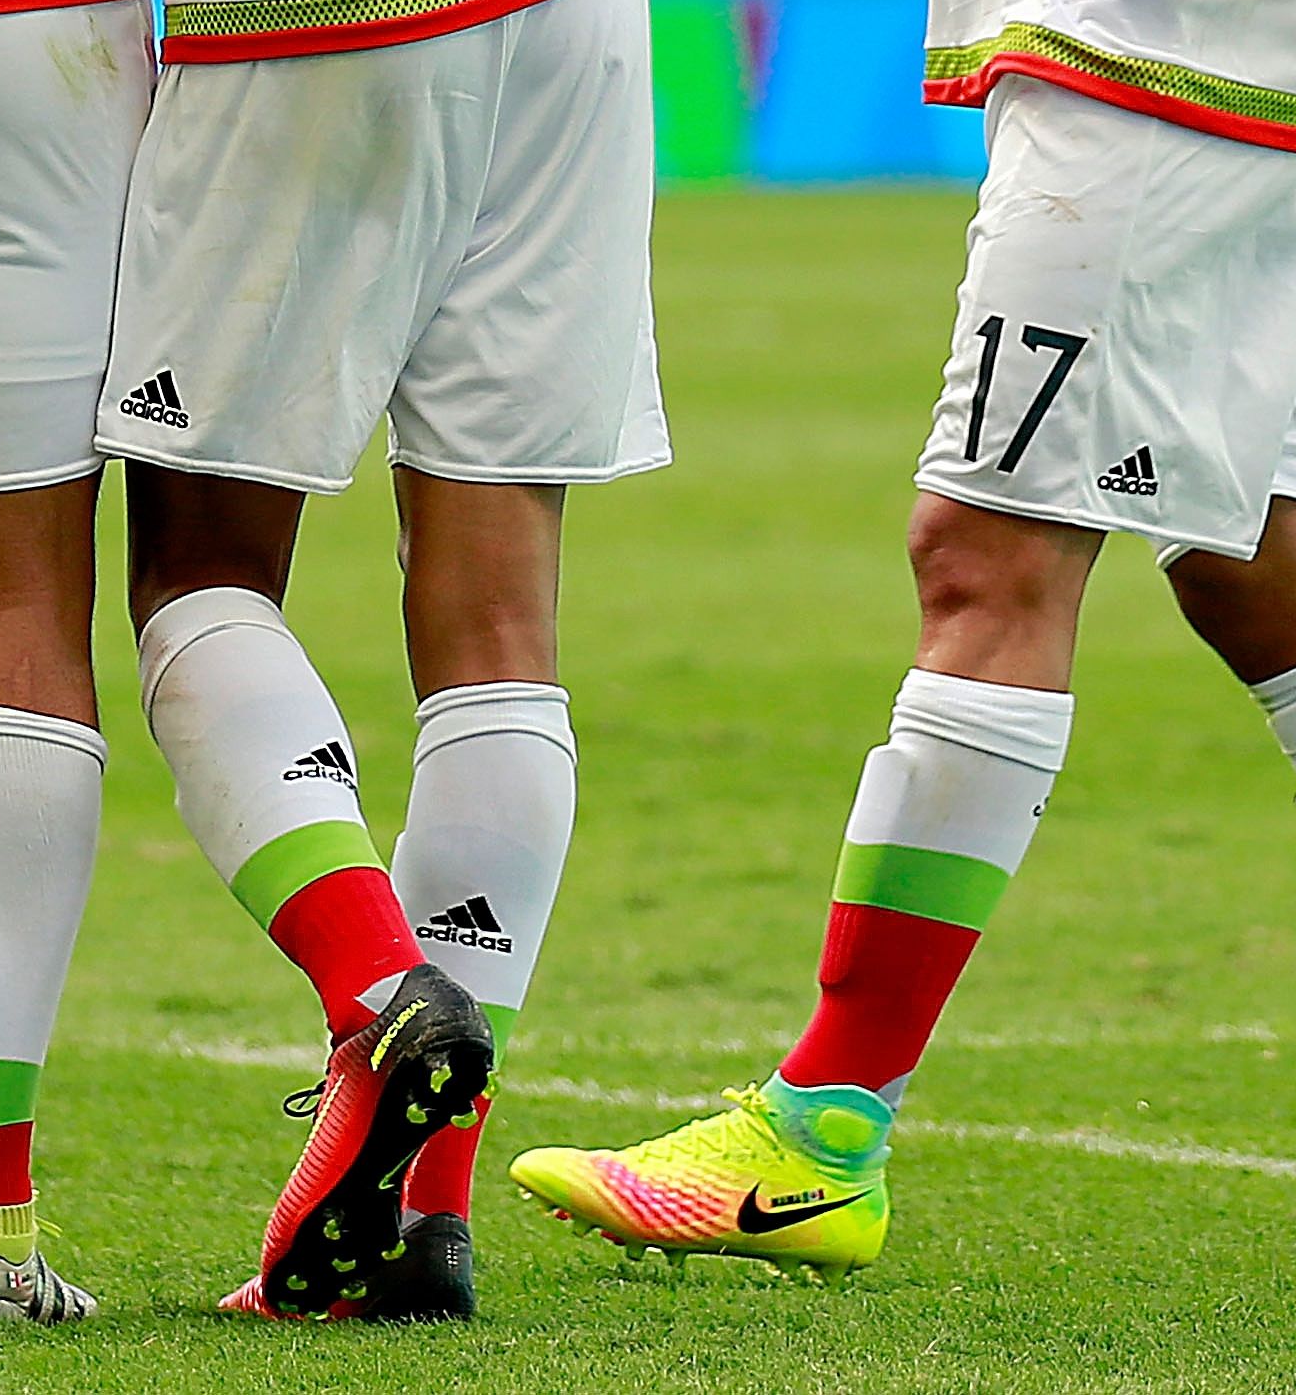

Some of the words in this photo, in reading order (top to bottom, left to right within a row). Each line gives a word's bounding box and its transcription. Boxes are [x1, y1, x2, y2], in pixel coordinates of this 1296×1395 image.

[963, 315, 1088, 474] 17
[120, 398, 189, 429] adidas
[283, 764, 357, 791] adida
[415, 925, 512, 954] adidas
